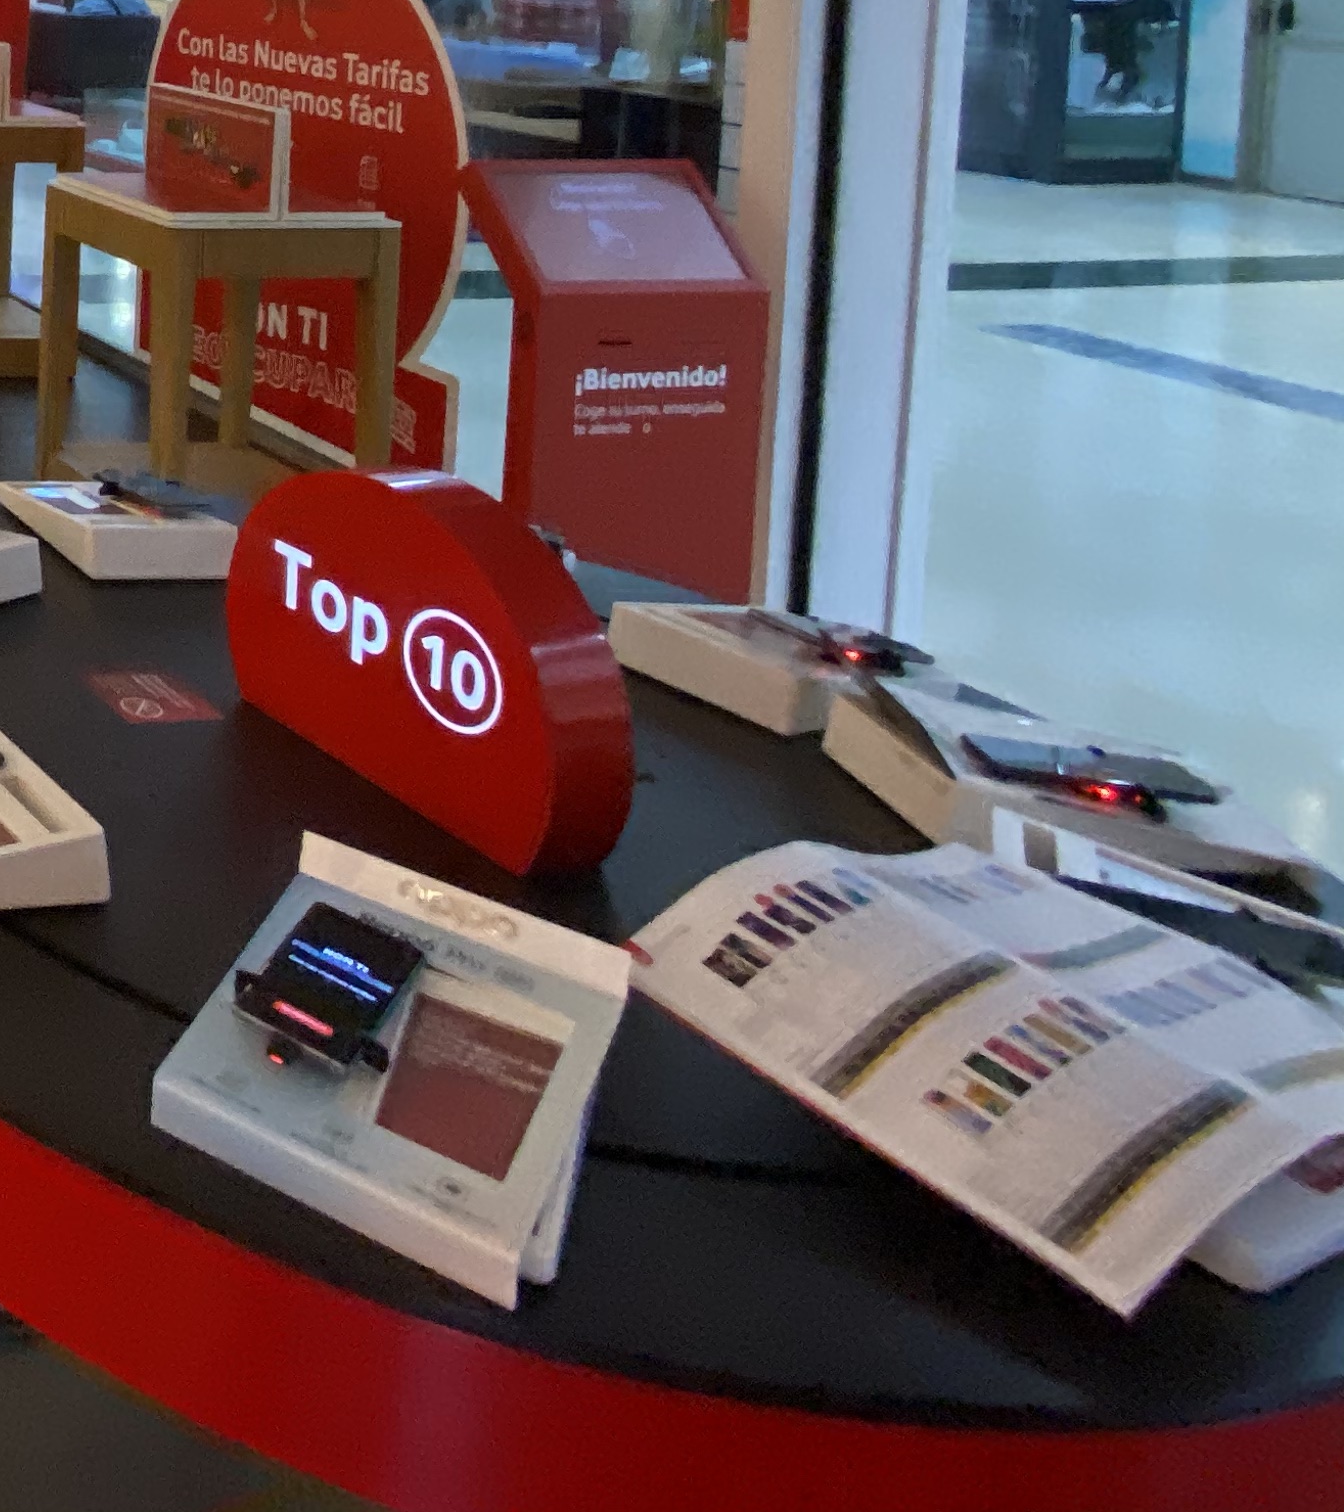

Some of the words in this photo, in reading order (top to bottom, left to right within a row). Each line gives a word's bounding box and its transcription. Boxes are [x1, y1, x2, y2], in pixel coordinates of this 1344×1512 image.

[176, 27, 214, 58] Con
[218, 33, 249, 65] las
[253, 39, 338, 81] Nuevas
[342, 52, 430, 96] Tarifas
[190, 65, 211, 91] te
[215, 68, 234, 96] lo
[238, 79, 343, 121] ponemos
[349, 92, 405, 134] fácil
[297, 304, 329, 351] TI
[574, 364, 727, 396] ¡Bienvenido!
[273, 538, 390, 666] Top
[420, 634, 487, 712] 10
